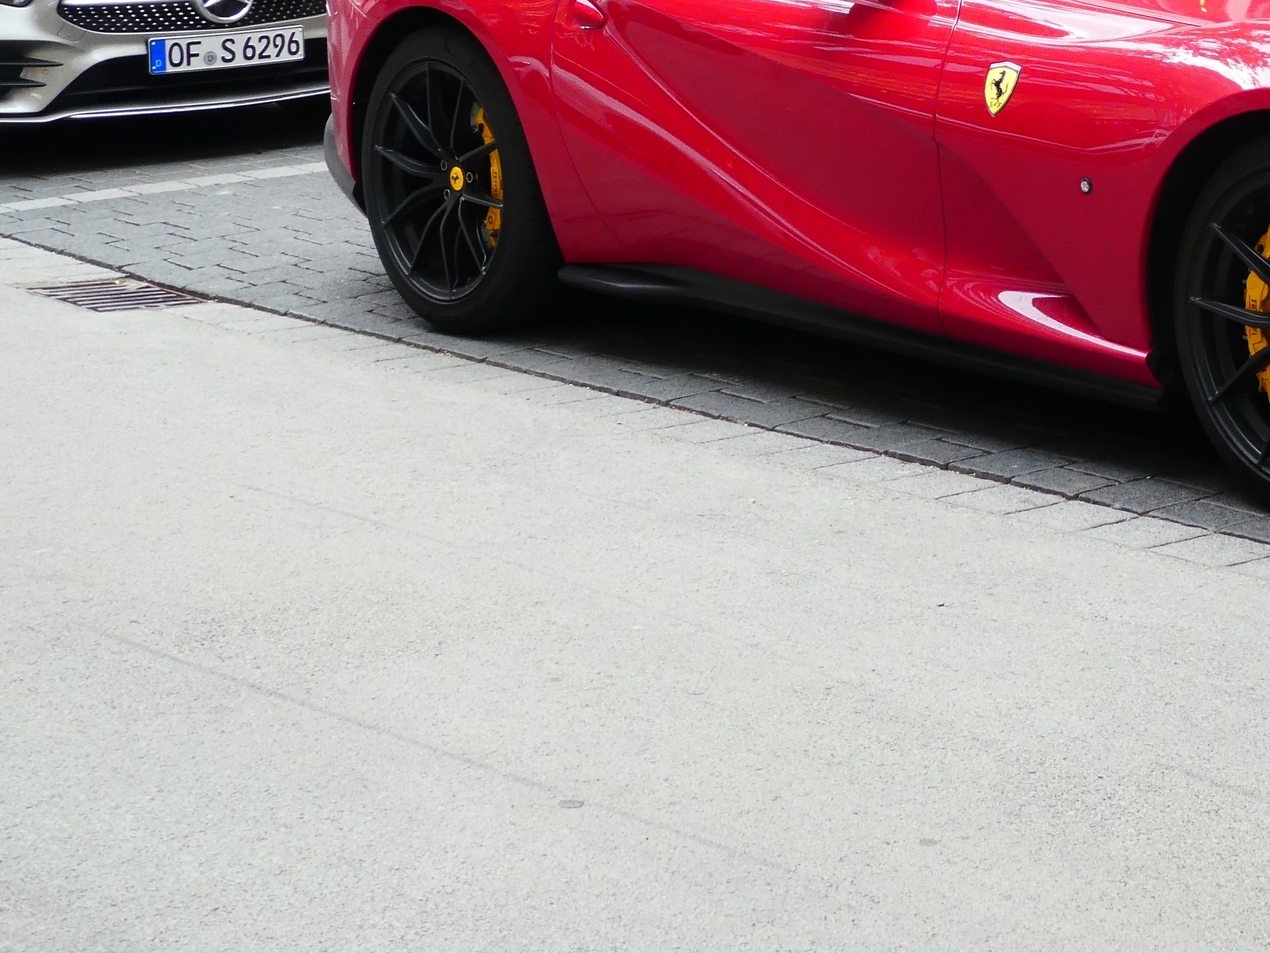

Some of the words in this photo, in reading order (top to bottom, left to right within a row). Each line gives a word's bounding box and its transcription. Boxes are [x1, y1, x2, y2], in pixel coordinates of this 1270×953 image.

[168, 40, 202, 68] OF
[220, 38, 236, 64] S
[242, 31, 300, 61] 6296
